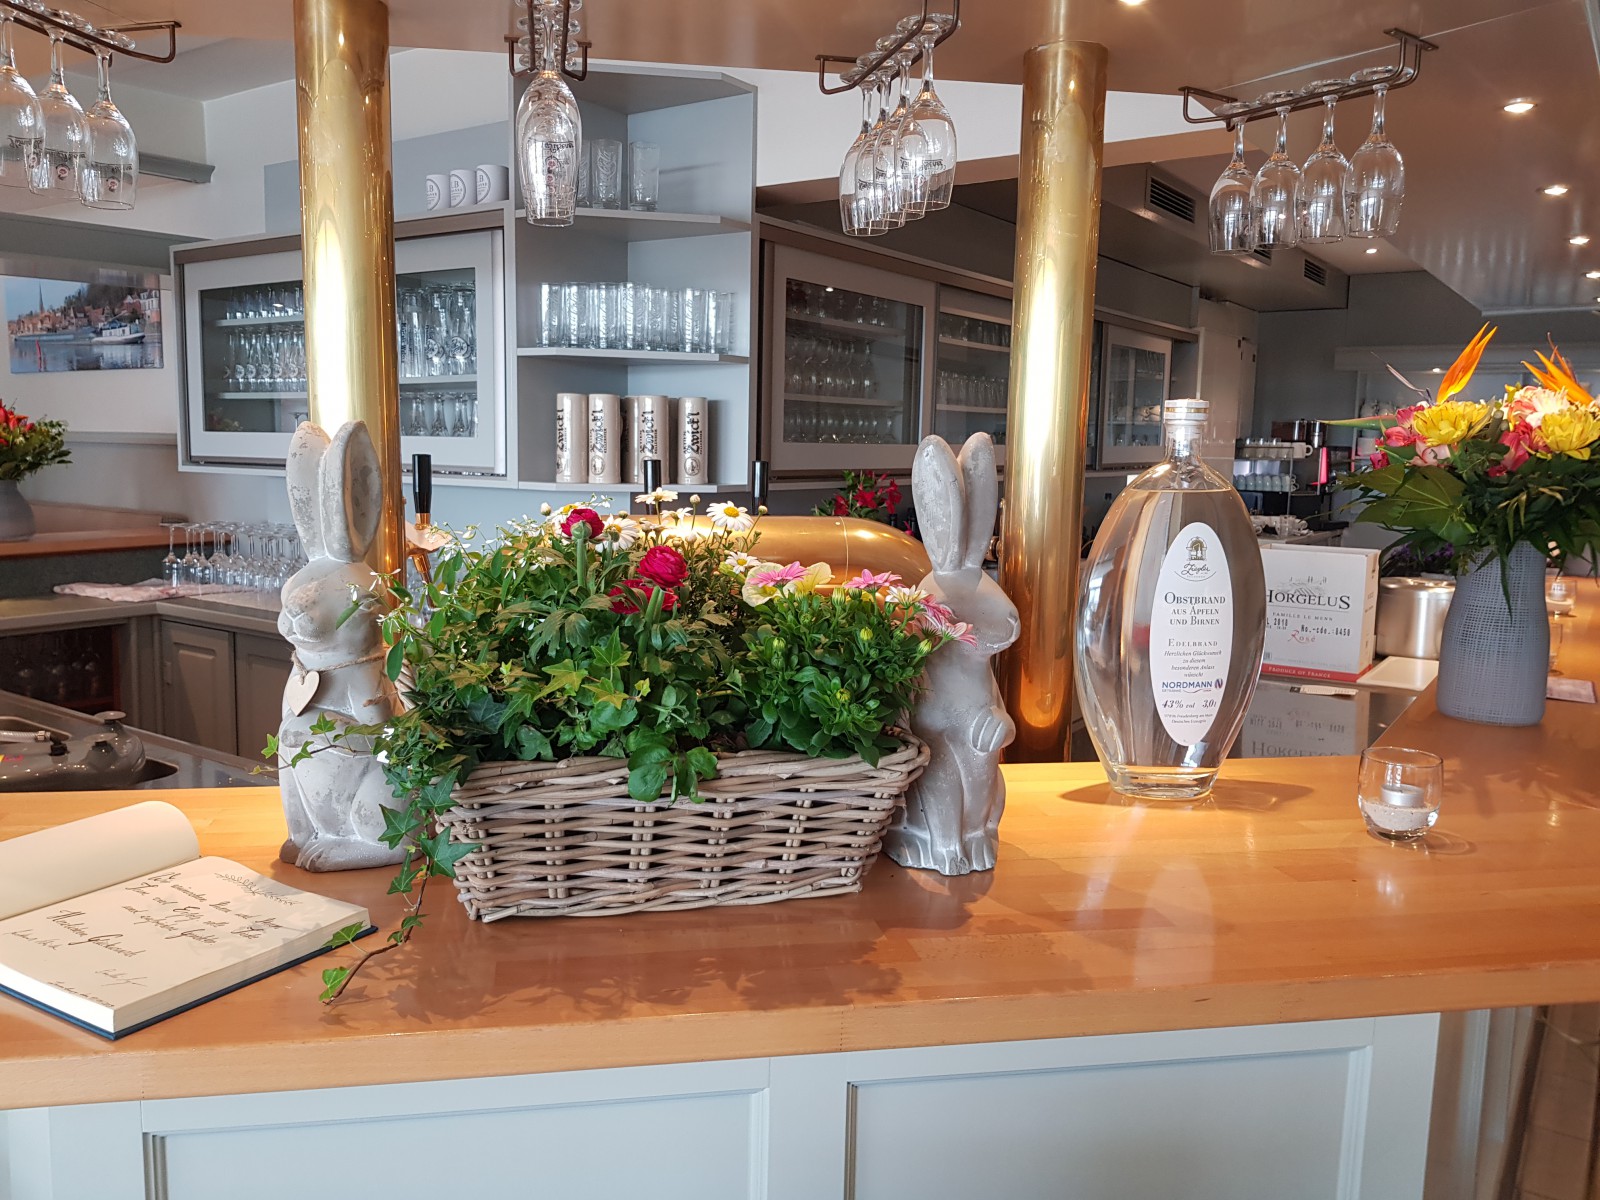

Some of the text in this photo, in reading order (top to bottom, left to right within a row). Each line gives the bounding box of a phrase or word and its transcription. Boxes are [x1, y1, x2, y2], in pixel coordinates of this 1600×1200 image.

[1164, 592, 1226, 605] OBSTBRAND
[1266, 589, 1351, 610] HORGELUS
[1169, 616, 1220, 626] UND BIRNEN
[1288, 629, 1316, 643] Rosé
[1168, 638, 1218, 647] EDELBRAND
[1162, 681, 1213, 689] NORDMANN
